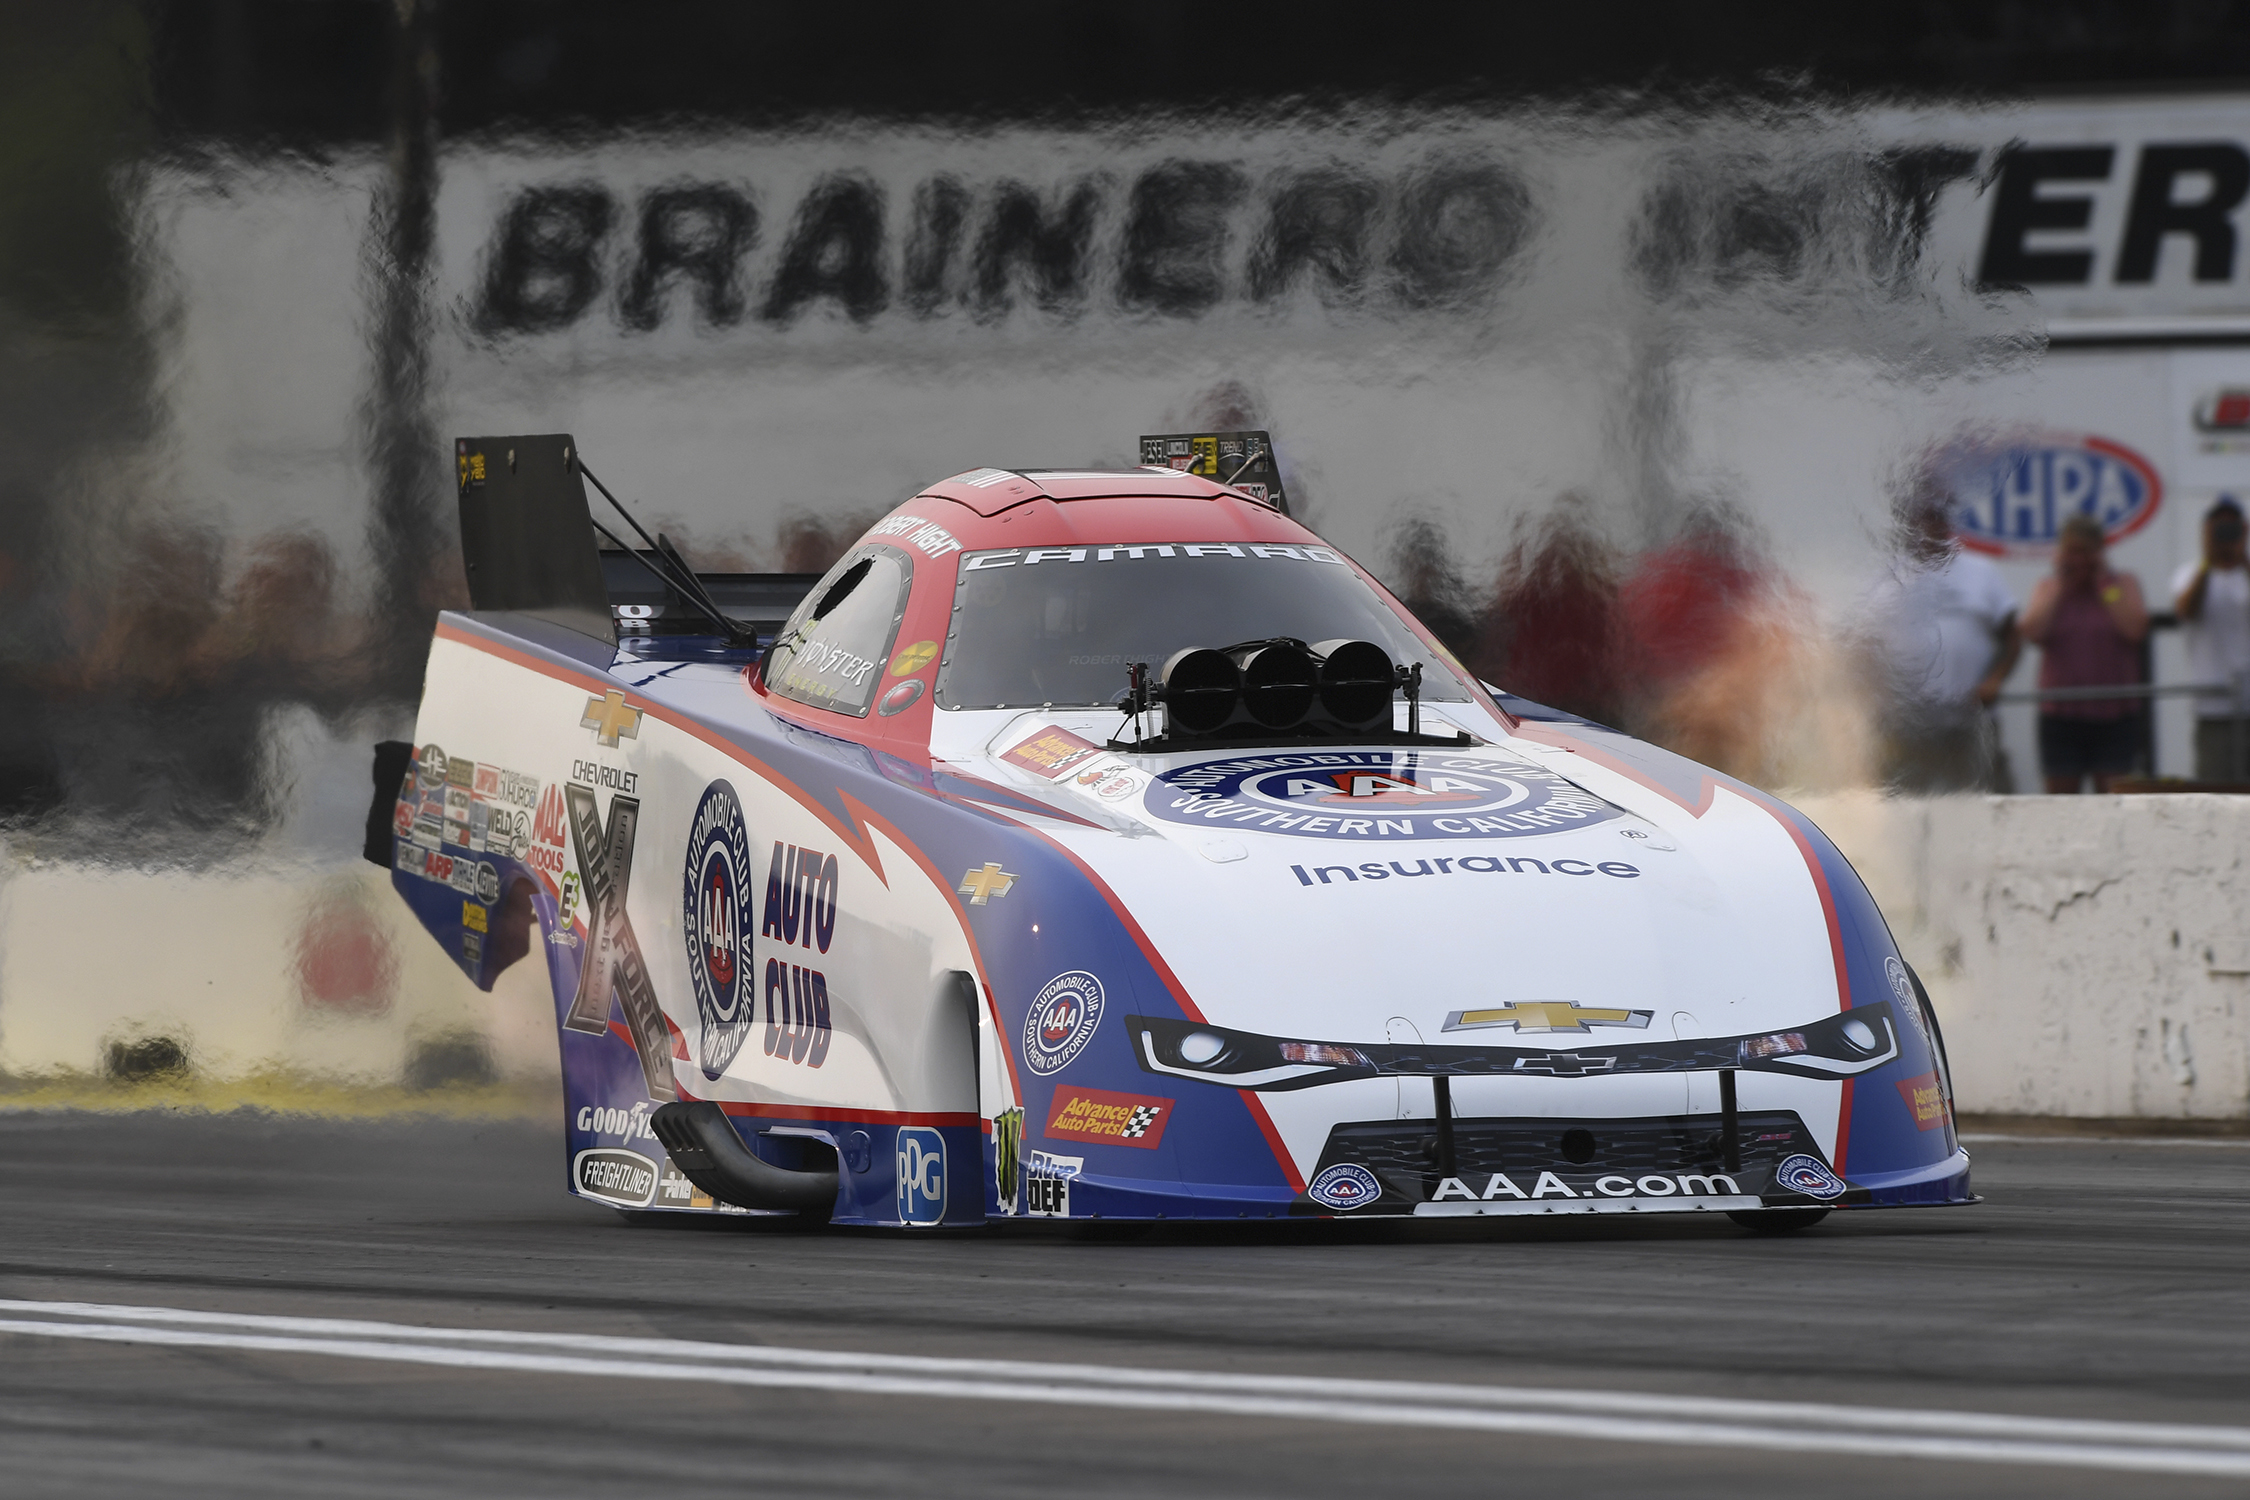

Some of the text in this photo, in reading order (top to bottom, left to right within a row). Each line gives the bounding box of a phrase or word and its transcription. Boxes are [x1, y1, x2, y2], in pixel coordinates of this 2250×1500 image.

[1220, 440, 1243, 454] TREND
[905, 521, 964, 560] HIGHT
[965, 544, 1346, 572] CAMARO
[797, 638, 875, 686] MONSTER
[787, 673, 837, 699] ENERGY
[573, 759, 639, 794] CHEVROLET
[1165, 754, 1561, 788] AUTOMOBILE CLUB
[1287, 774, 1491, 798] AAA
[488, 806, 512, 836] WELD
[532, 783, 565, 848] MAC
[1170, 788, 1415, 835] SOUTHERN
[531, 845, 564, 873] TOOLS
[687, 792, 750, 902] AUTOMOBILE CLUB
[425, 852, 453, 880] ARP
[578, 809, 620, 925] JOHN
[1290, 855, 1641, 887] Insurance
[762, 839, 839, 955] AUTO
[703, 887, 735, 958] AAA
[612, 925, 669, 1074] FORCE
[712, 932, 752, 1069] CALIFORNIA
[1037, 976, 1099, 1013] AUTOMOBILE CLUB
[763, 957, 833, 1070] CLUB
[1043, 1006, 1077, 1031] AAA
[1027, 1018, 1096, 1070] SOUTHERN CALIFORNIA
[577, 1104, 659, 1143] GOODYE
[1052, 1114, 1121, 1136] Auto Parts
[1062, 1097, 1129, 1121] Advance
[583, 1159, 653, 1196] FREIGHTLINER
[899, 1137, 941, 1214] PPG
[1028, 1151, 1078, 1179] Blue
[1315, 1167, 1377, 1191] AUTOMOBILE CLUB
[1780, 1158, 1830, 1181] AUTOMOBILE CLUB
[1795, 1176, 1824, 1186] AAA
[1028, 1179, 1067, 1213] DEF
[1329, 1186, 1360, 1195] AAA
[1431, 1171, 1742, 1200] AAA.com
